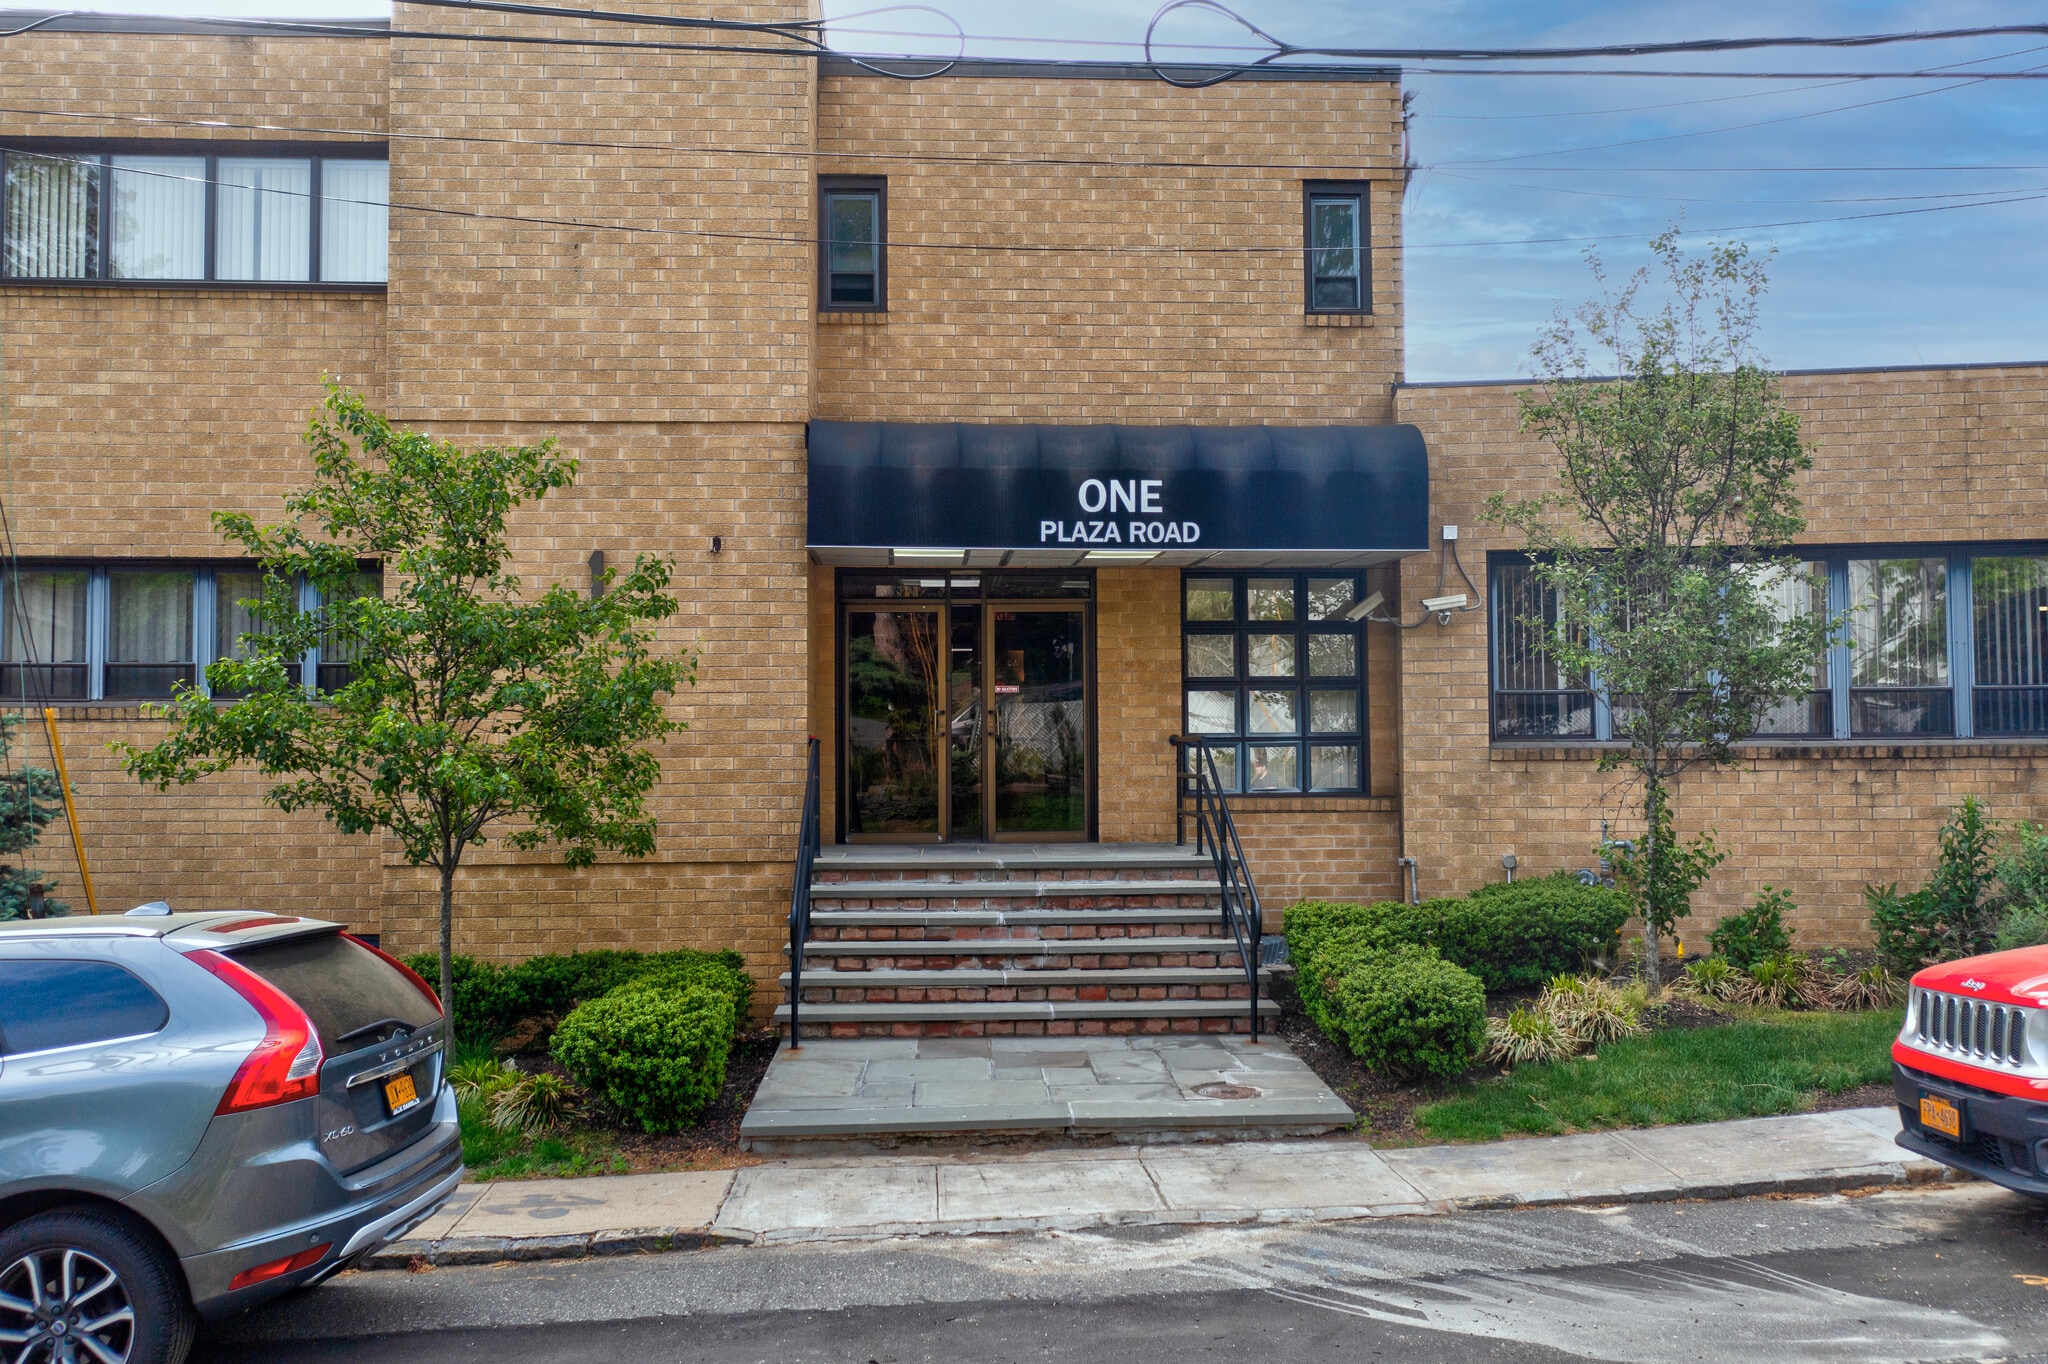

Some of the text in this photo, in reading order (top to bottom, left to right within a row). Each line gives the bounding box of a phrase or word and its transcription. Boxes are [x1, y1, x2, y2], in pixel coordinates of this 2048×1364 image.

[1078, 478, 1163, 513] ONE
[1040, 521, 1201, 543] PLAZA ROAD
[1961, 978, 1986, 992] Jeep
[379, 1035, 433, 1062] VOLVO
